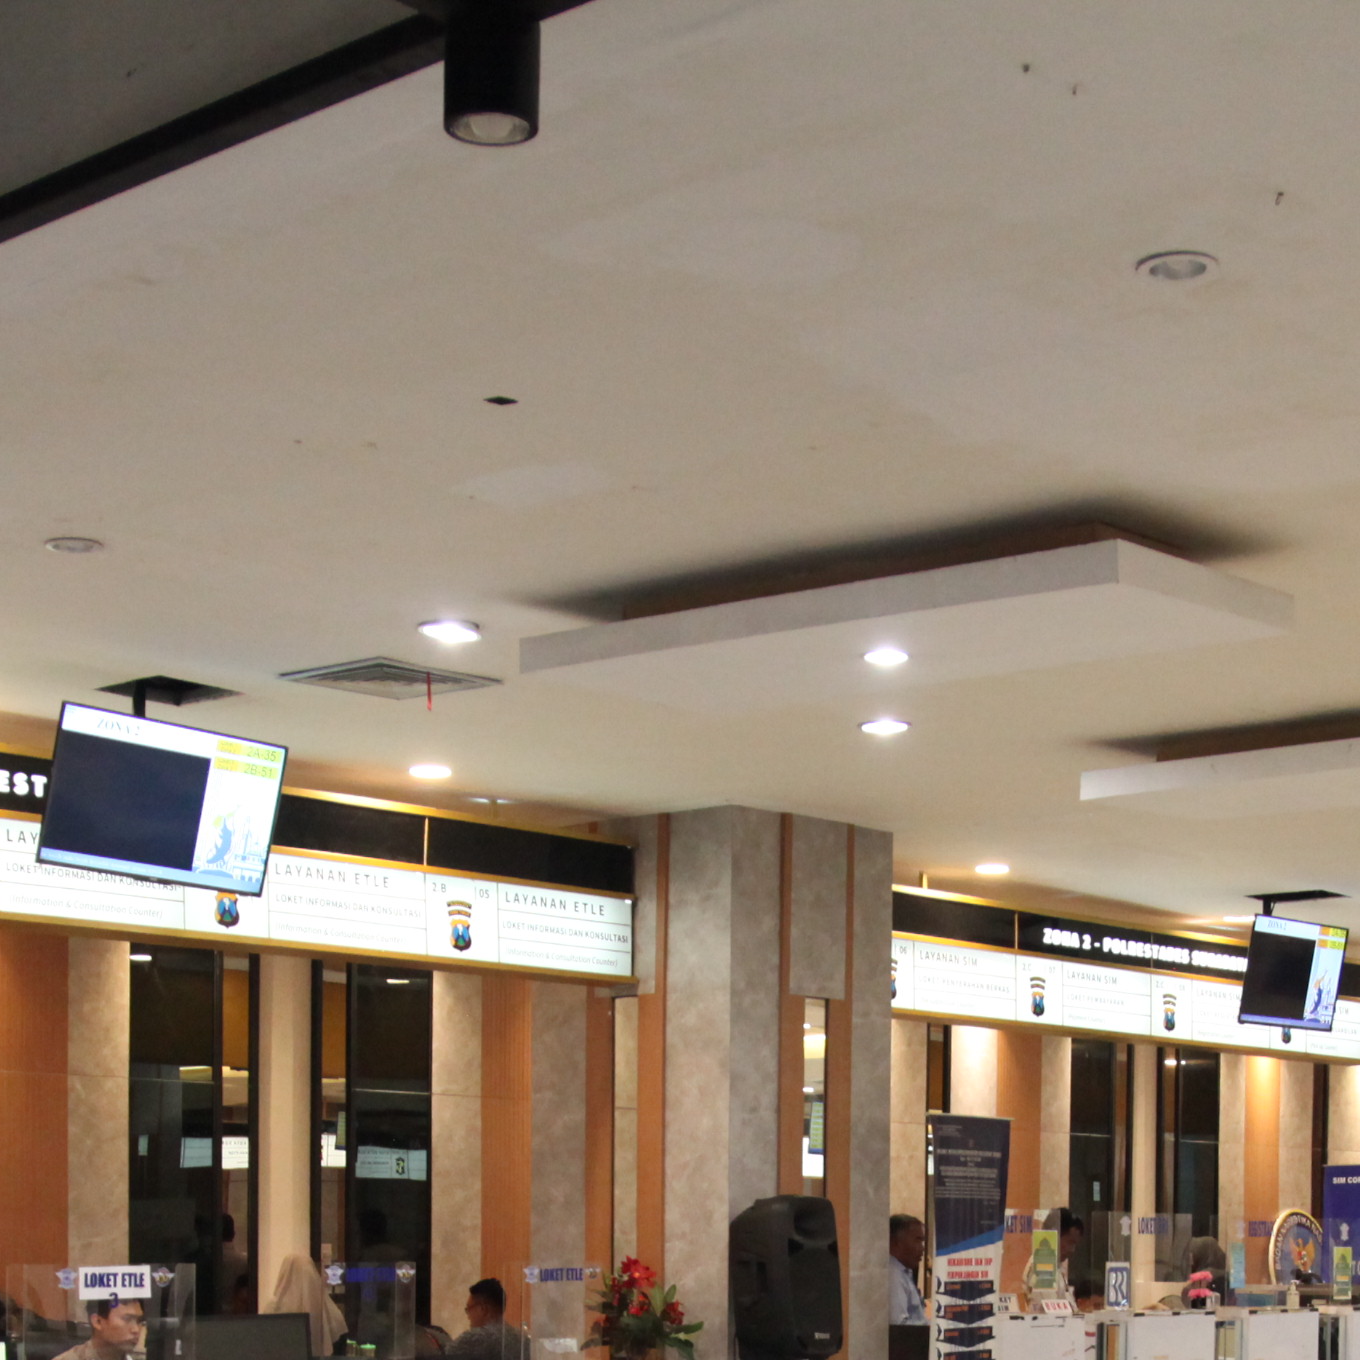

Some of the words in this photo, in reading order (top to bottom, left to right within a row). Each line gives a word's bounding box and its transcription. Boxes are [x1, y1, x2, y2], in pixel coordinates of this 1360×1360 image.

[246, 746, 276, 761] 2A-35
[244, 764, 273, 778] 2B-51
[6, 863, 38, 874] LOKET
[40, 865, 94, 880] INFORMASI
[96, 872, 116, 884] DAN
[275, 863, 345, 883] LAYANAN
[355, 873, 389, 888] ETLE
[479, 889, 489, 899] 05
[276, 894, 303, 904] LOKET
[306, 897, 350, 909] INFORMASI
[353, 903, 368, 912] DAN
[371, 905, 420, 918] KONSULTASI
[506, 892, 566, 910] LAYANAN
[574, 901, 605, 916] ETLE
[503, 921, 526, 930] LOKET
[527, 924, 566, 935] INFORMASI
[569, 928, 583, 937] DAN
[585, 930, 628, 943] KONSULTASI
[1043, 928, 1079, 948] ZONA
[920, 950, 959, 965] LAYANAN
[963, 956, 977, 966] SIM
[1067, 970, 1101, 984] LAYANAN
[1104, 974, 1117, 985] SIM
[84, 1273, 118, 1288] LOKET
[121, 1272, 145, 1288] ETLE
